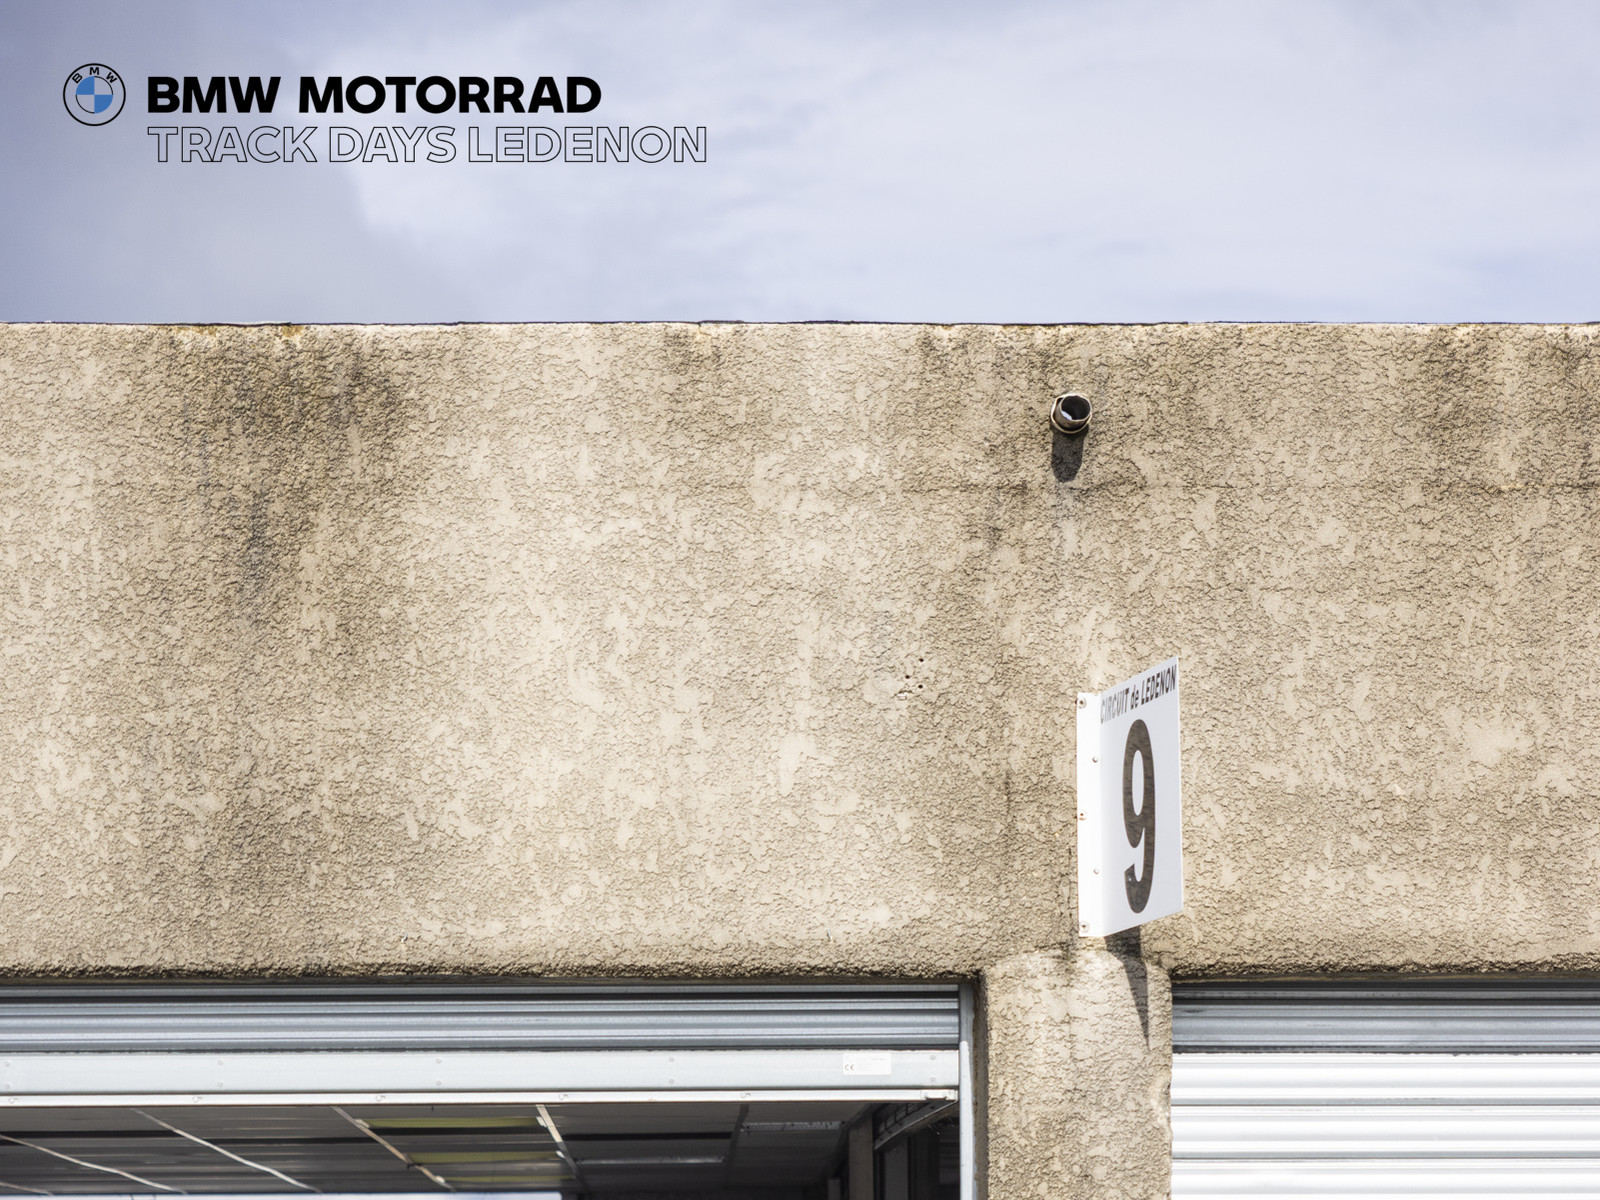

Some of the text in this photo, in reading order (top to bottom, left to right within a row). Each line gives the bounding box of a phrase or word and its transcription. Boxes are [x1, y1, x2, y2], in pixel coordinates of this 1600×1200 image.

[1101, 665, 1177, 724] CIRCUIT de LEDENON
[1122, 719, 1156, 914] 9
